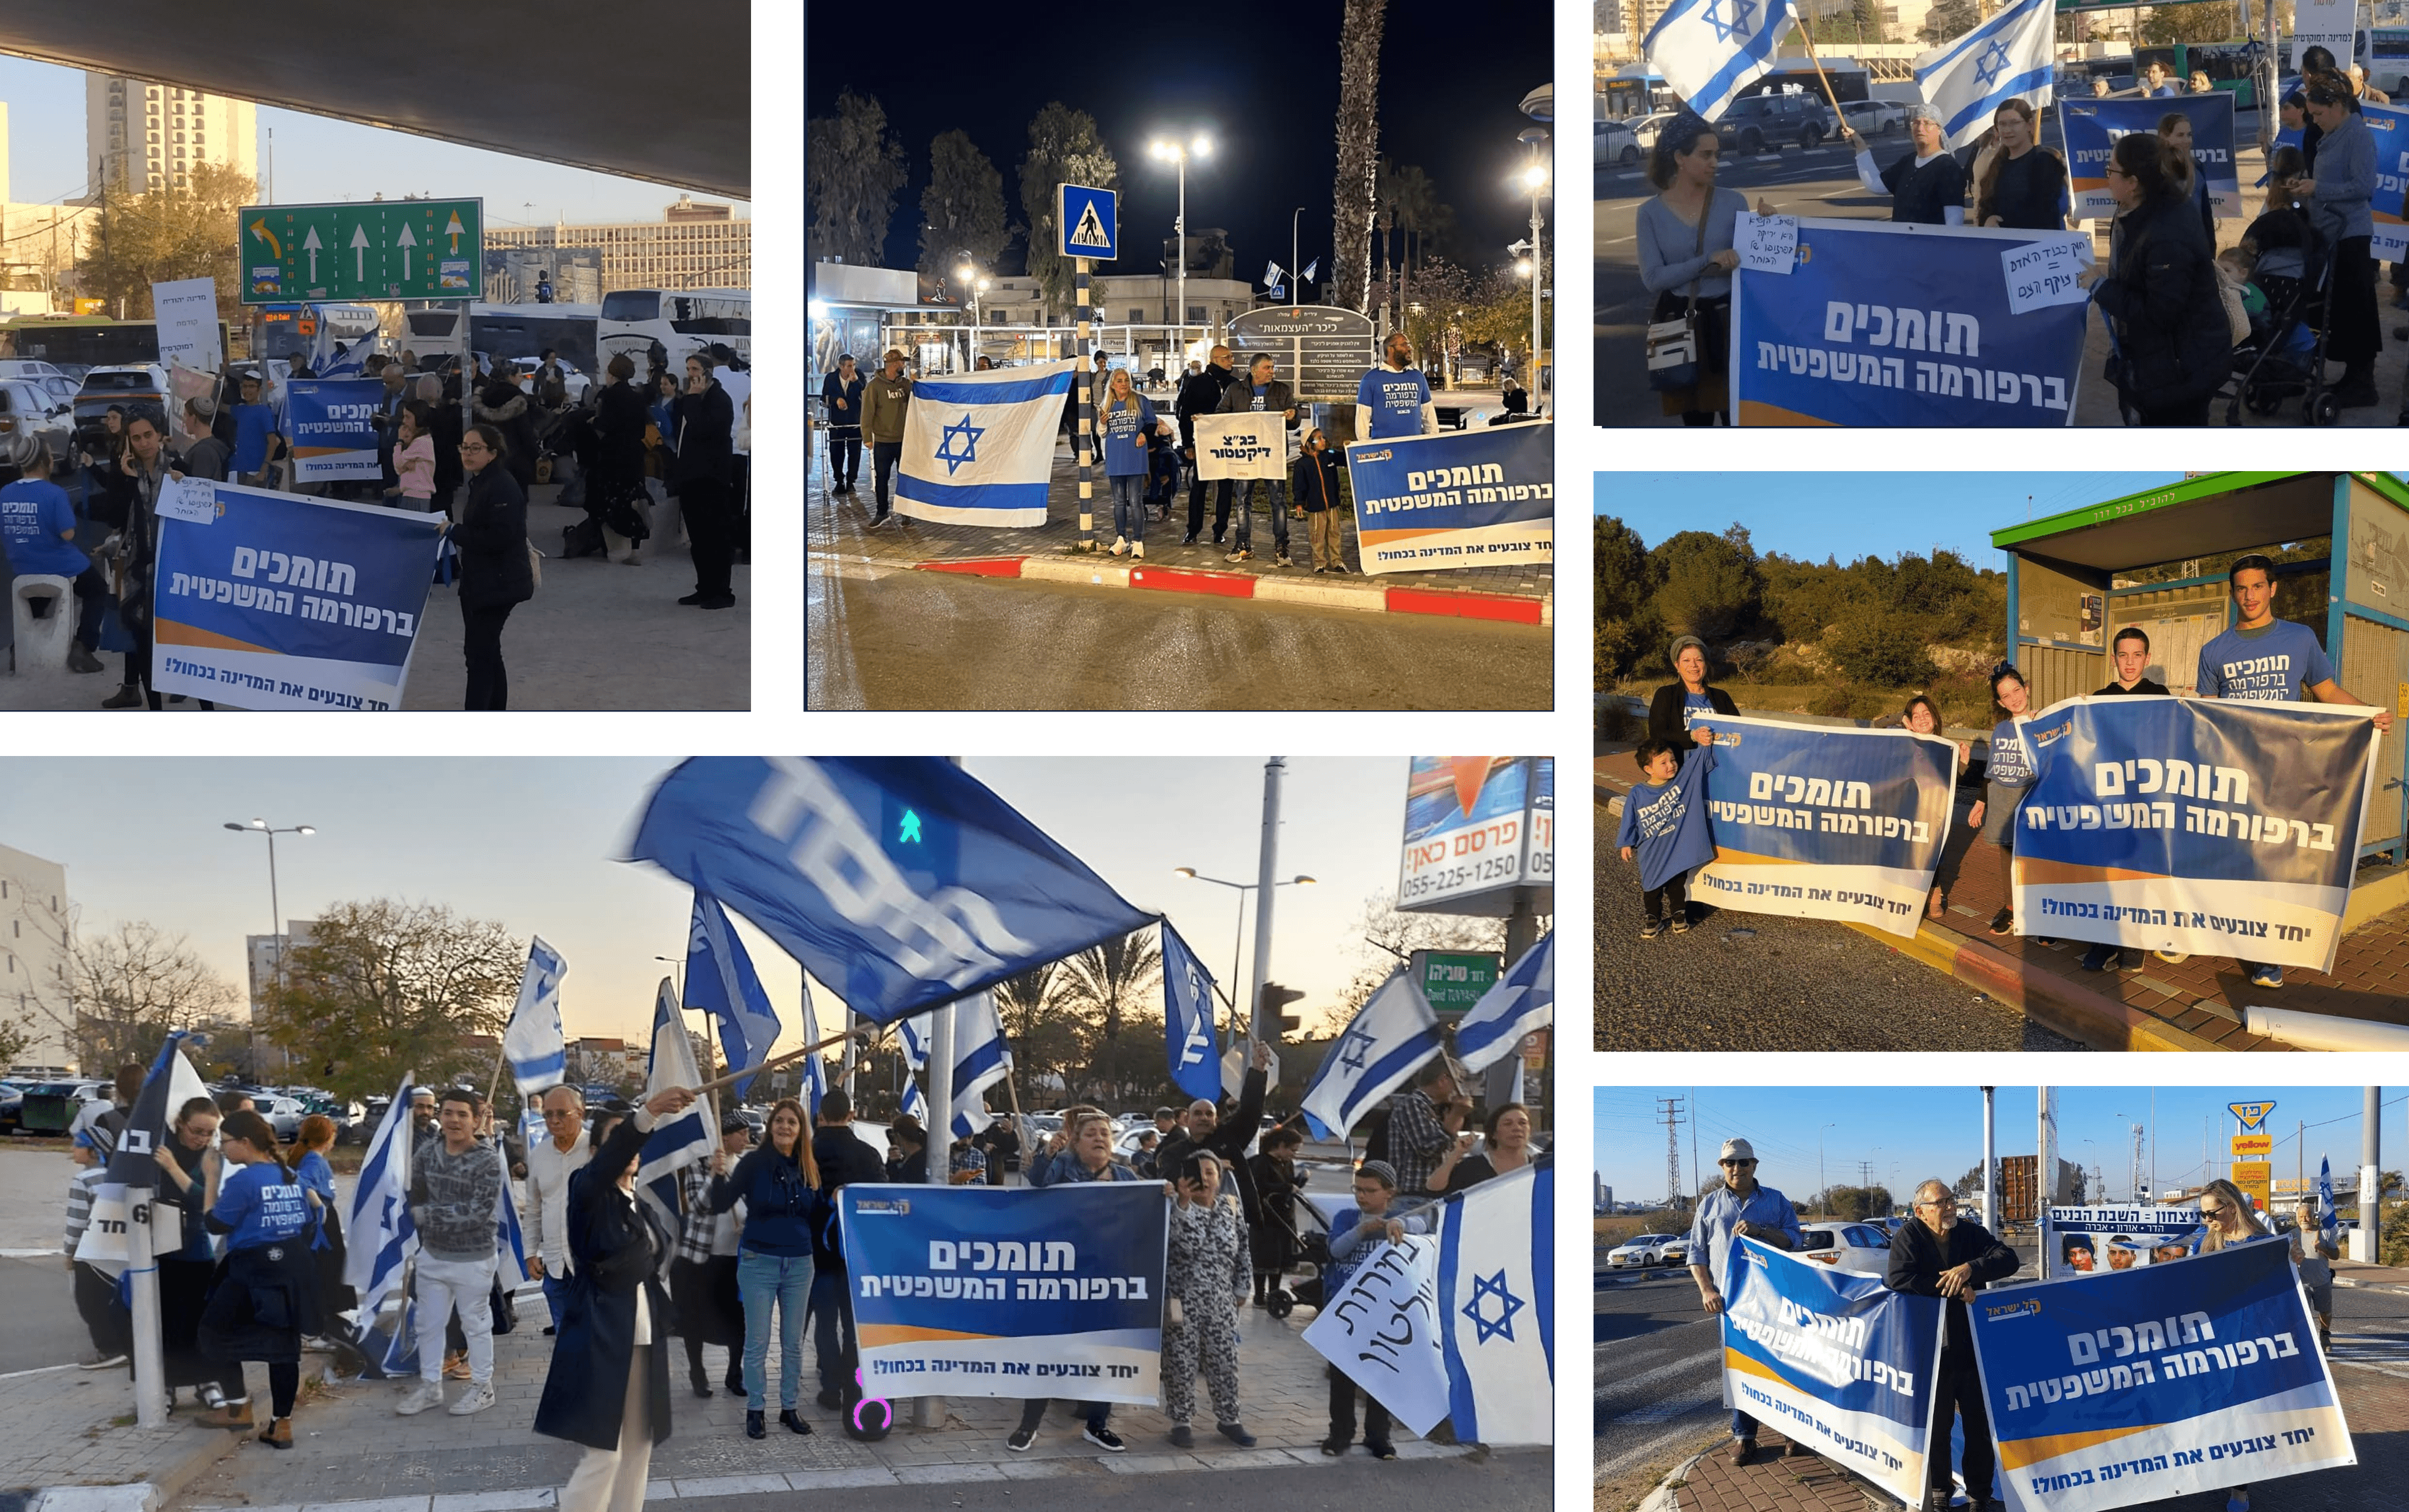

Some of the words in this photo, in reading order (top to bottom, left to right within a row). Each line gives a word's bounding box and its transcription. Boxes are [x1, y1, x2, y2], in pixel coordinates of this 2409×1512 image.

[2294, 34, 2326, 44] דמוקרטית
[2327, 33, 2352, 42] למדינה
[2042, 245, 2068, 258] כבוד
[2071, 242, 2085, 258] חוק
[2010, 252, 2041, 272] האדם
[1258, 323, 1313, 334] "העצמאות"
[1316, 323, 1337, 332] כיכר
[1824, 301, 1980, 358] תומכים
[1757, 341, 1905, 389] המשפטית
[1383, 382, 1418, 392] תומכים
[1916, 361, 2068, 410] ברפורמה
[1385, 391, 1418, 400] ברפורמה
[1385, 400, 1418, 408] המשפטית
[298, 422, 364, 434] המשפטית
[1109, 417, 1135, 427] ברפורמה
[1223, 434, 1257, 445] בג"צ
[1210, 447, 1272, 461] דיקטטור
[306, 463, 333, 471] בכחול!
[336, 462, 364, 470] המדינה
[1407, 463, 1504, 491] תומכים
[1467, 483, 1553, 504] ברפורמה
[2140, 492, 2175, 508] להוביל
[1366, 491, 1461, 515] המשפטית
[2115, 504, 2133, 514] בכל
[2094, 510, 2109, 521] דרך
[1378, 550, 1417, 561] בכחול!
[1420, 546, 1462, 557] המדינה
[1466, 545, 1484, 555] את
[1488, 543, 1531, 553] צובעים
[231, 546, 356, 595] תומכים
[169, 572, 294, 615] המשפטית
[301, 595, 414, 637] ברפורמה
[166, 658, 216, 680] בכחול!
[2223, 654, 2290, 679] תומכים
[221, 669, 275, 692] המדינה
[280, 681, 303, 698] את
[2228, 673, 2286, 690] ברפורמה
[308, 688, 363, 710] צובעים
[1749, 772, 1871, 809] תומכים
[2095, 759, 2250, 805] תומכים
[2026, 802, 2176, 831] המשפטית
[1821, 812, 1929, 843] ברפורמה
[2186, 804, 2335, 851] ברפורמה
[1454, 821, 1517, 857] פרסם
[1406, 841, 1446, 873] כאן!
[1403, 854, 1515, 898] 055-225-1250
[1703, 873, 1743, 892] בכחול!
[1748, 883, 1802, 898] המדינה
[1807, 888, 1832, 902] את
[1837, 893, 1885, 909] צובעים
[1888, 900, 1912, 916] יחד
[2041, 898, 2099, 919] בכחול!
[2103, 905, 2167, 926] המדינה
[2173, 910, 2206, 929] את
[2210, 914, 2268, 937] צובעים
[2275, 924, 2311, 942] יחד
[2241, 1105, 2260, 1117] פז
[2235, 1140, 2270, 1151] yellow
[261, 1184, 302, 1201] תומכים
[132, 1204, 149, 1225] 6
[2053, 1210, 2092, 1221] הבנים
[2097, 1210, 2139, 1222] השבת
[2117, 1224, 2137, 1233] אורון
[929, 1240, 1076, 1272] תומכים
[860, 1275, 1006, 1300] המשפטית
[1016, 1277, 1149, 1301] ברפורמה
[1986, 1303, 2019, 1316] ישראל
[1777, 1296, 1865, 1350] תומכים
[2067, 1311, 2216, 1366] תומכים
[2161, 1331, 2299, 1380] ברפורמה
[873, 1359, 926, 1375] בכחול!
[932, 1360, 996, 1375] המדינה
[1002, 1361, 1031, 1375] את
[1036, 1363, 1100, 1377] צובעים
[1107, 1365, 1139, 1378] יחד
[1741, 1382, 1773, 1407] בכחול!
[2005, 1360, 2156, 1411] המשפטית
[1775, 1398, 1813, 1426] המדינה
[1816, 1420, 1831, 1438] את
[2281, 1427, 2315, 1445] יחד
[1834, 1432, 1878, 1459] צובעים
[2210, 1434, 2277, 1461] צובעים
[1882, 1451, 1903, 1472] יחד
[2174, 1449, 2204, 1468] את
[2099, 1456, 2169, 1480] המדינה
[2032, 1469, 2095, 1495] בכחול!
